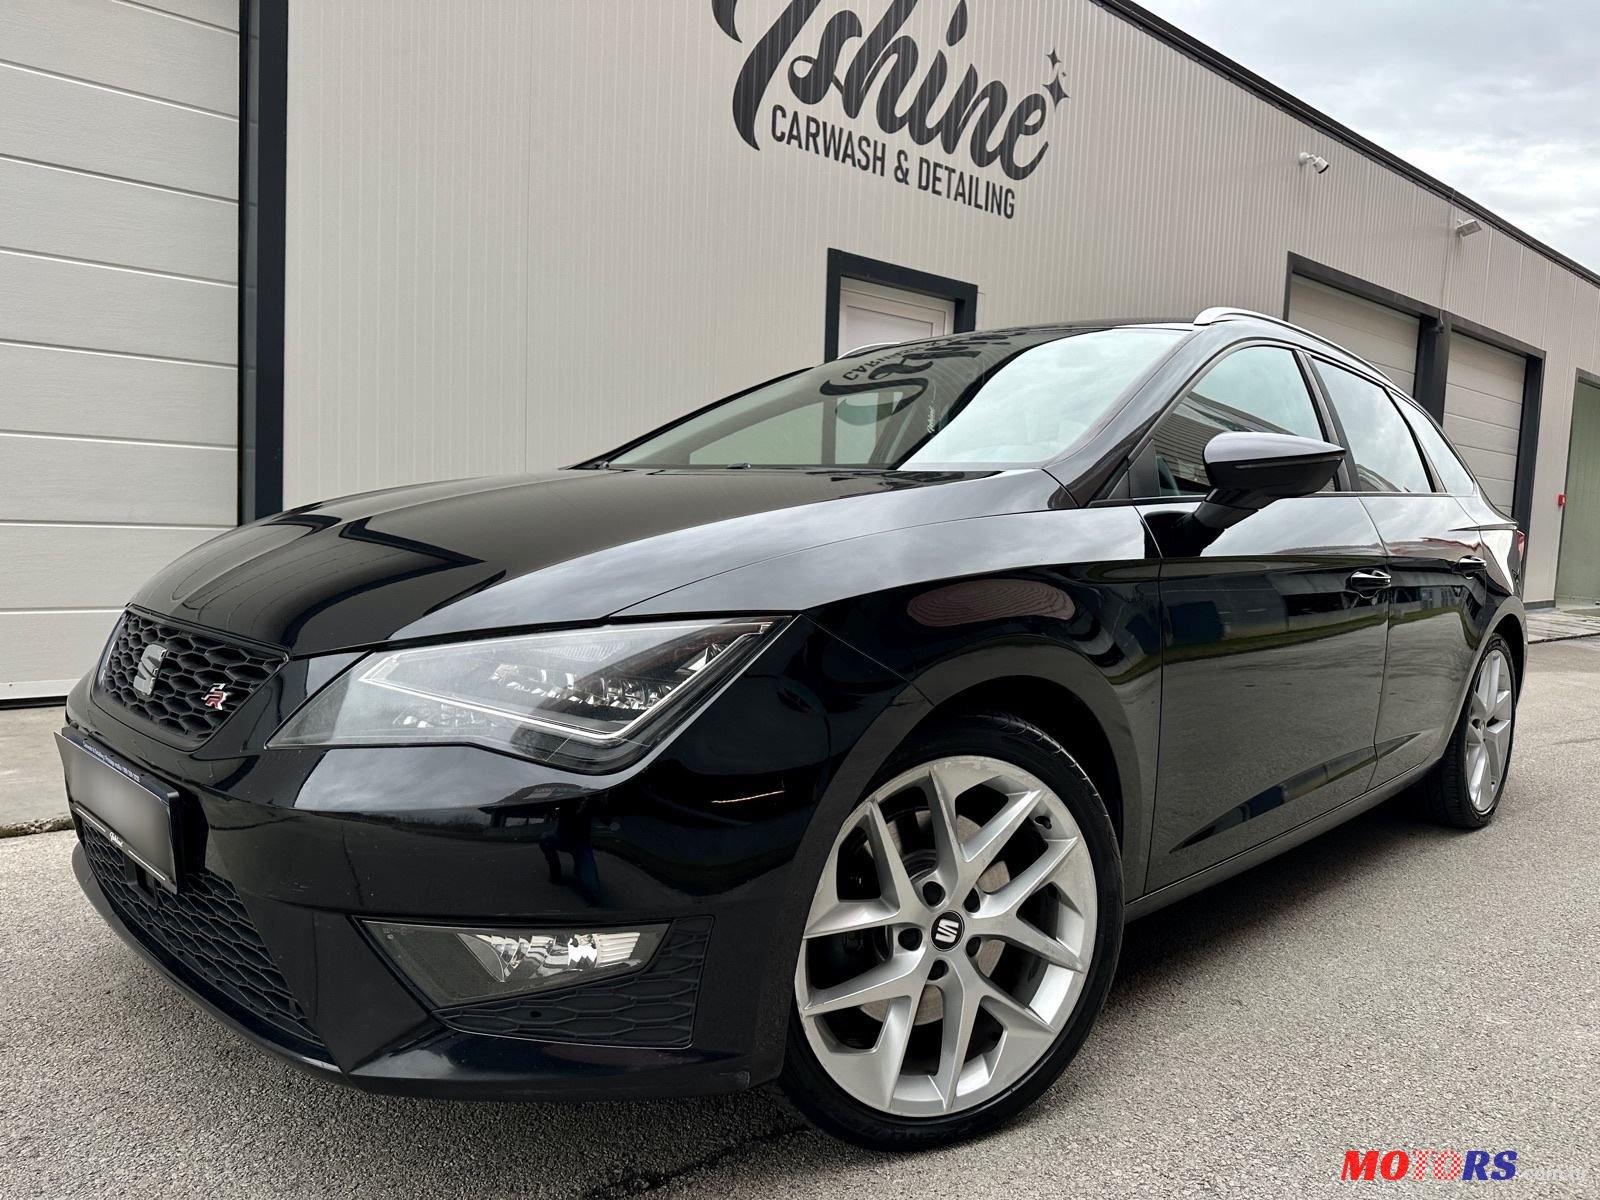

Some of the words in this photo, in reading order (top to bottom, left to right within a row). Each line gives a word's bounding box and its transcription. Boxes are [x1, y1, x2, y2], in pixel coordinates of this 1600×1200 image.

[771, 103, 887, 178] CARWASH
[893, 149, 910, 186] &
[917, 156, 1016, 220] DETAILING
